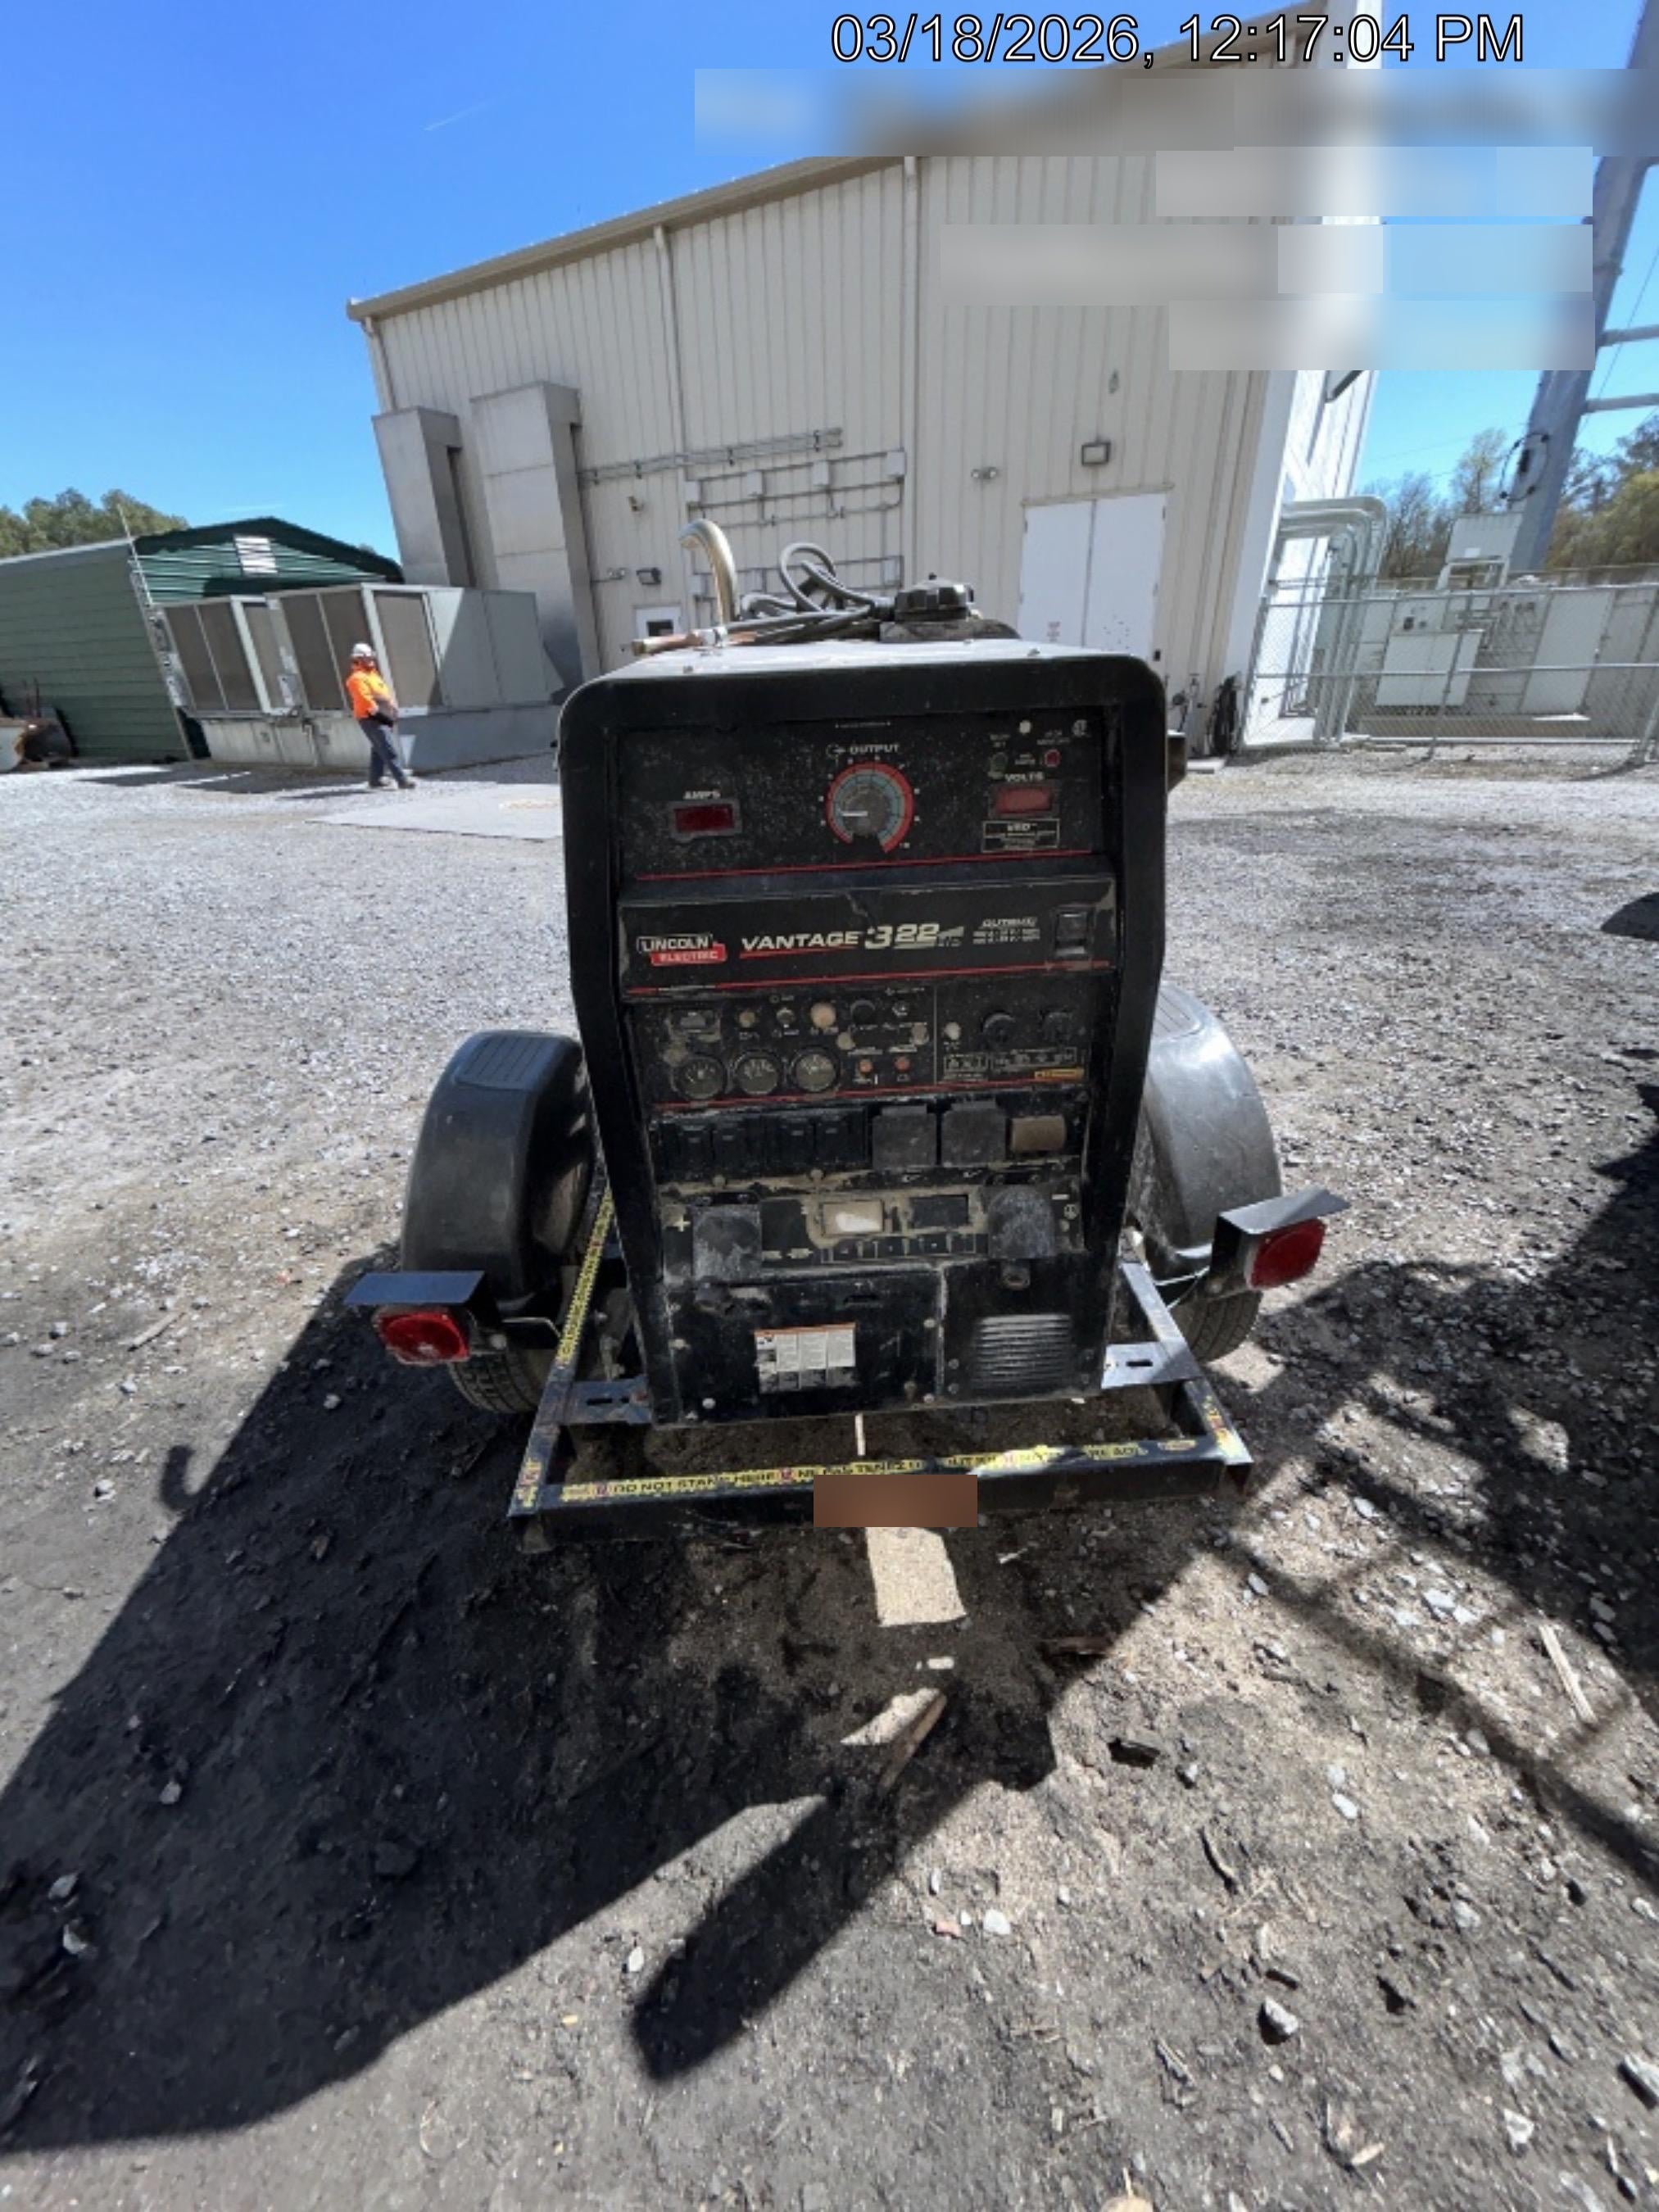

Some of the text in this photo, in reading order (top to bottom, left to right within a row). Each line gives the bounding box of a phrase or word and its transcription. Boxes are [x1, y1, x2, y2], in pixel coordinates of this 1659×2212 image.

[850, 743, 899, 755] OUTPUT
[682, 789, 721, 800] AMPS
[741, 931, 863, 950] VANTAGE
[864, 922, 940, 950] 322
[639, 936, 710, 952] LINCOLN
[658, 950, 719, 963] ELECTRIC
